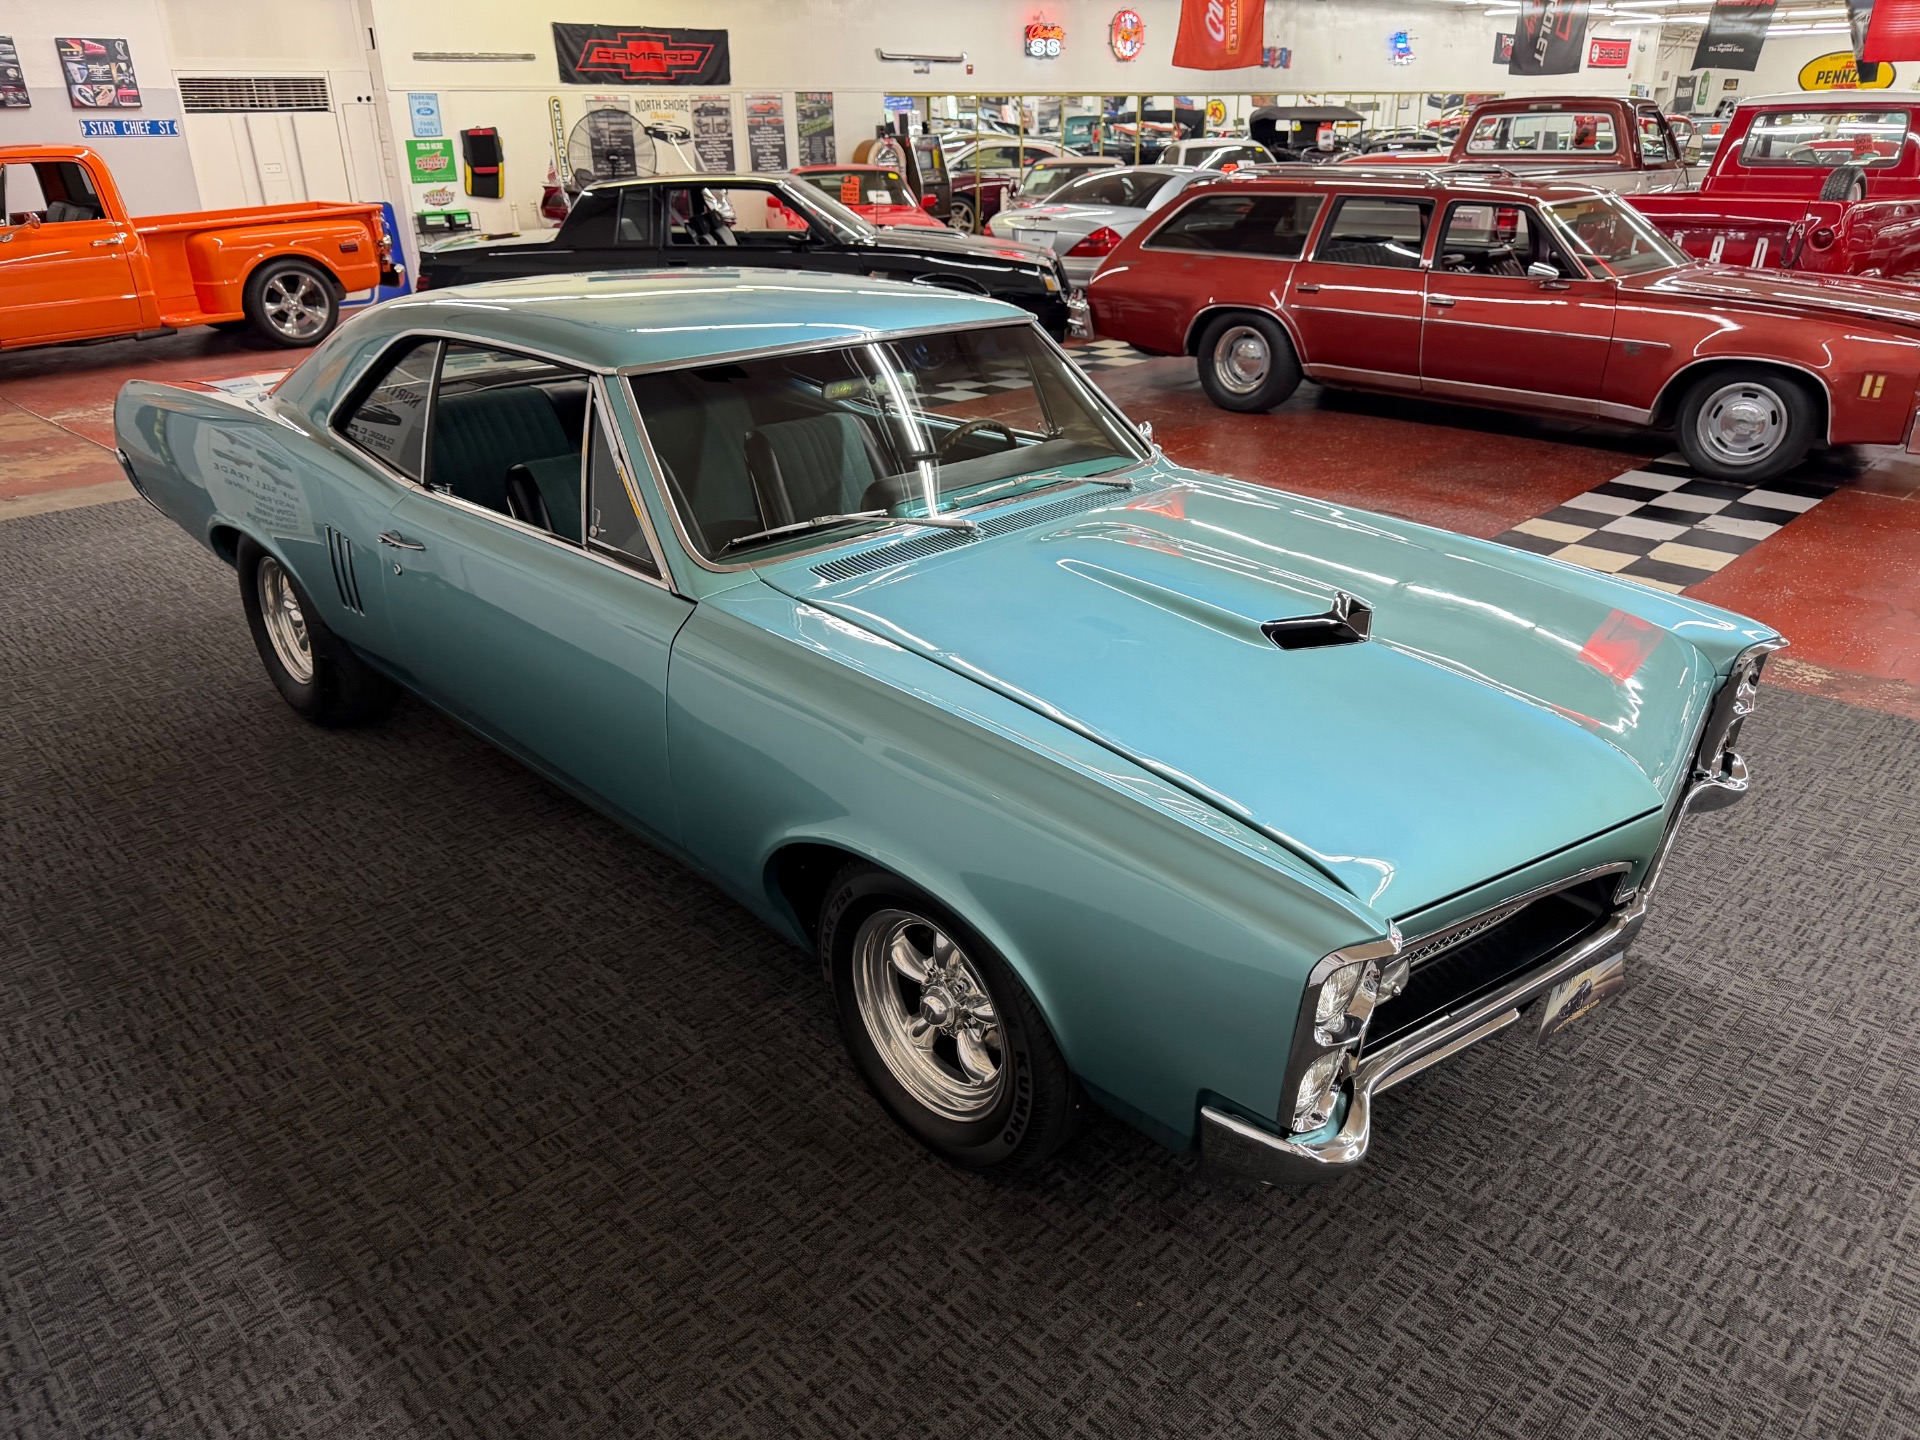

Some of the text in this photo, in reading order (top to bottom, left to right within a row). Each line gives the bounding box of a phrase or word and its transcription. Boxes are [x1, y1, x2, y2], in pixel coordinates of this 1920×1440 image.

[1030, 39, 1061, 56] SS
[1600, 48, 1628, 59] SHELBY
[597, 51, 695, 62] CAMARO
[1815, 69, 1860, 84] PENNZ
[635, 99, 689, 113] NORTH SHORE
[90, 121, 171, 135] STAR CHIEF ST
[1003, 1050, 1030, 1146] KUMHO
